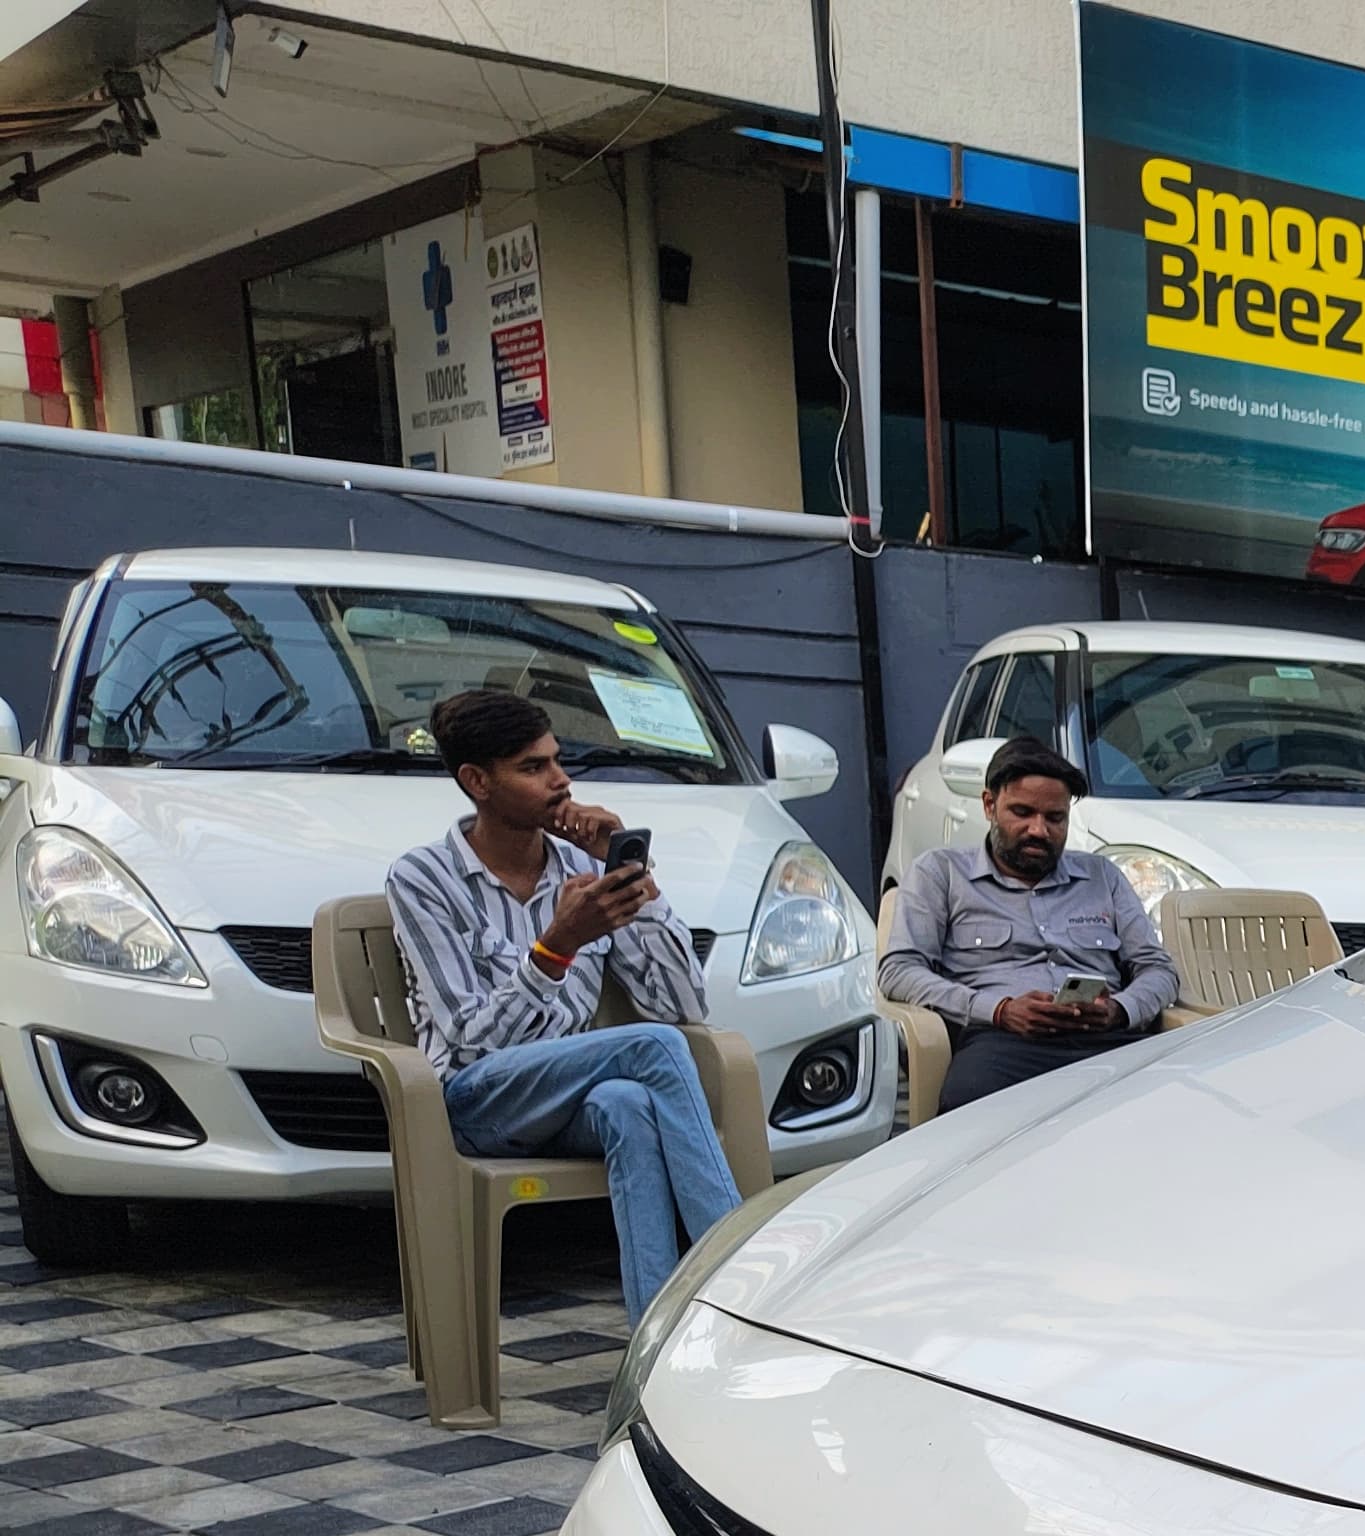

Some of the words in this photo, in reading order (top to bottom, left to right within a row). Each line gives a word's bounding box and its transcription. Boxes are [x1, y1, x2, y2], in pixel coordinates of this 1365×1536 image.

[425, 363, 468, 402] INDORE
[1190, 388, 1247, 416] Speedy
[1250, 399, 1279, 418] and
[1282, 402, 1361, 433] hassle-free
